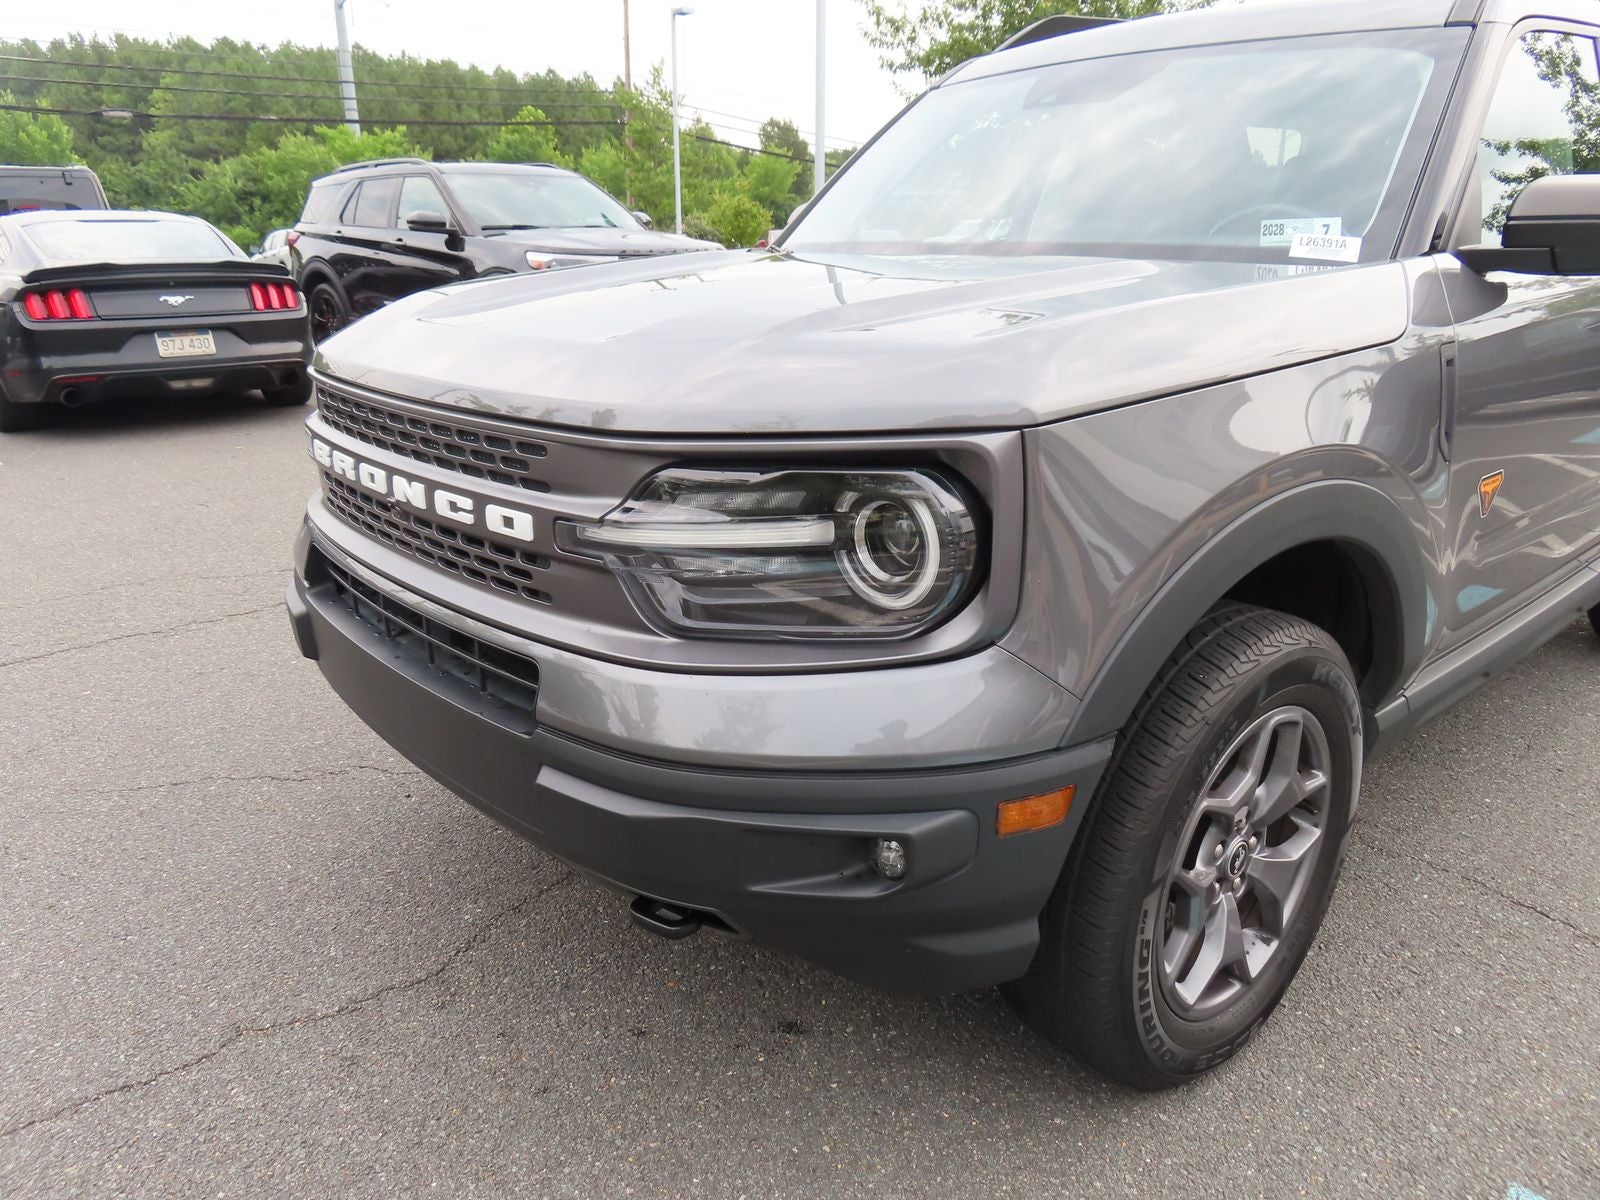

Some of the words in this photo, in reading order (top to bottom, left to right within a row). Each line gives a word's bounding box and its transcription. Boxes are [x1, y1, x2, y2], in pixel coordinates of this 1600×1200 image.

[1262, 223, 1285, 236] 2028
[1322, 224, 1330, 235] 7
[1299, 236, 1347, 248] L26391A
[161, 339, 185, 351] 97J
[189, 338, 210, 349] 430
[312, 438, 534, 541] BRONCO
